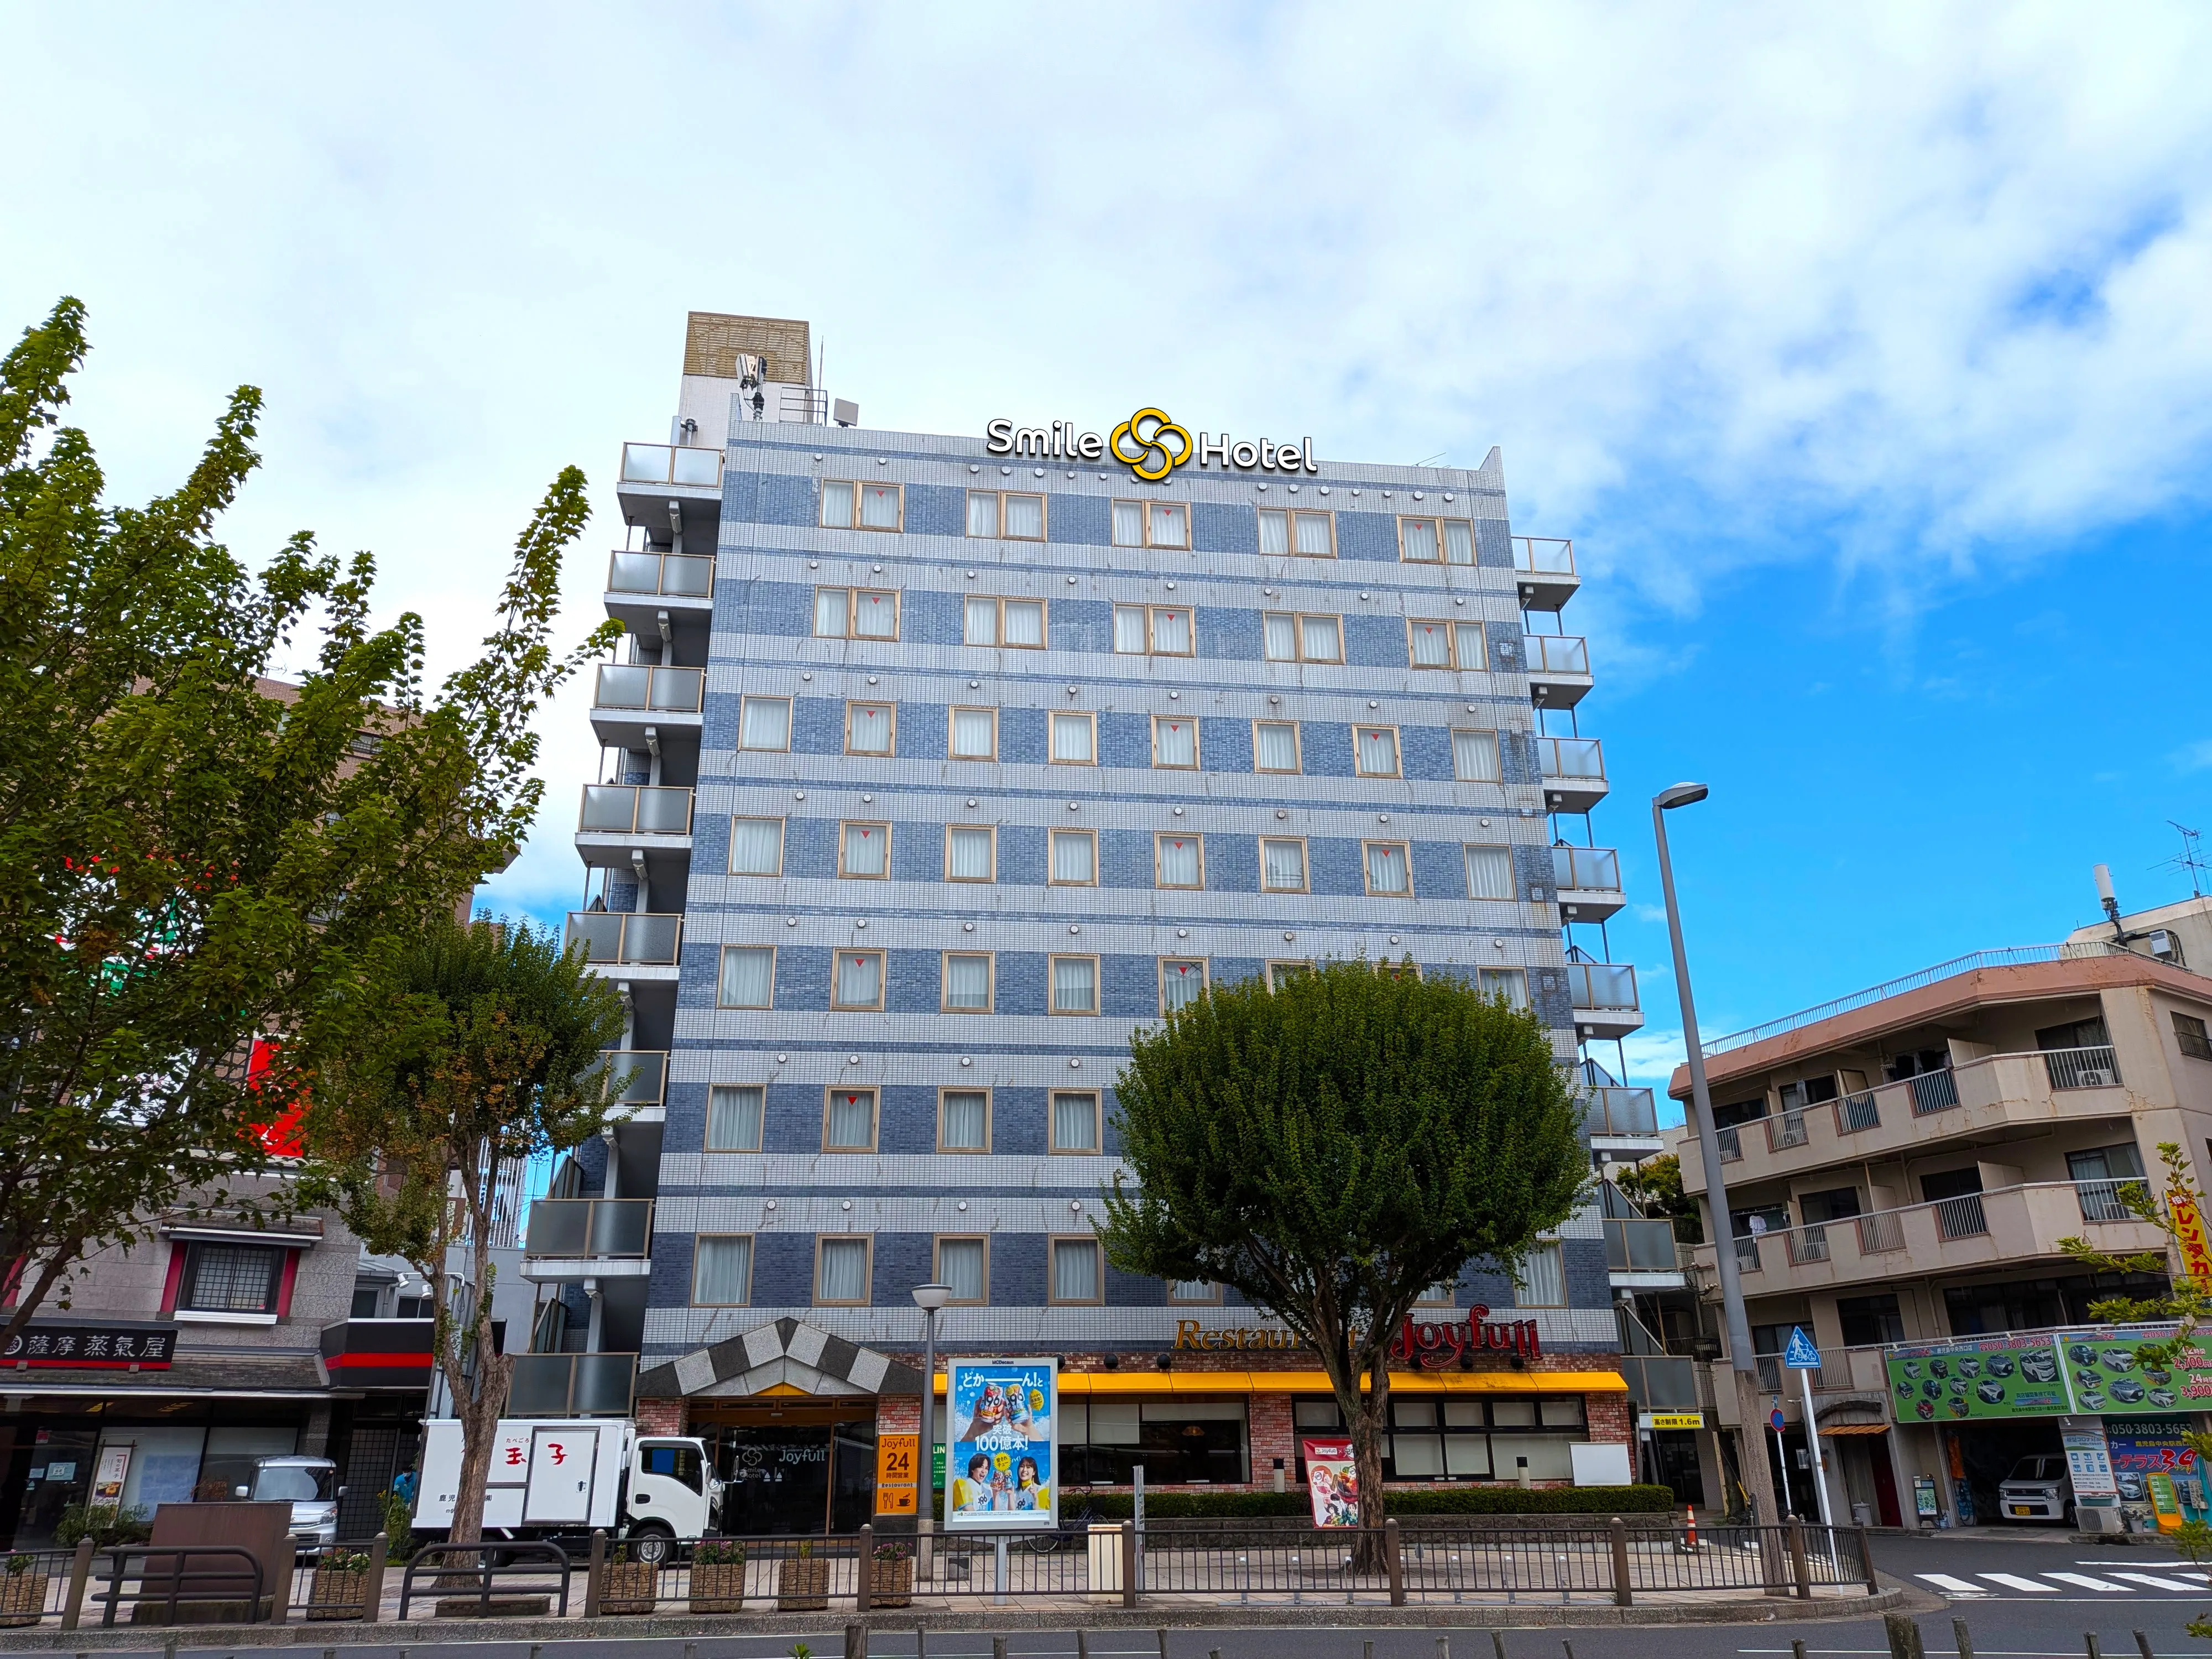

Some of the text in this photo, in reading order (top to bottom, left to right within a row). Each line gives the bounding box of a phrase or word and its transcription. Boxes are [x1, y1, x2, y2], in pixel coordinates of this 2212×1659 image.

[987, 419, 1318, 472] Smile Hotel
[1390, 1303, 1543, 1369] Joyfull
[1988, 1335, 2052, 1351] 050-3803-5653
[27, 1334, 166, 1358] 薩摩蒸氣屋
[993, 1425, 1011, 1434] 突破
[881, 1438, 915, 1449] Joyfull
[975, 1436, 1029, 1451] 100億本!
[2107, 1441, 2127, 1449] カー
[779, 1448, 825, 1464] Joyfull
[886, 1452, 910, 1471] 24
